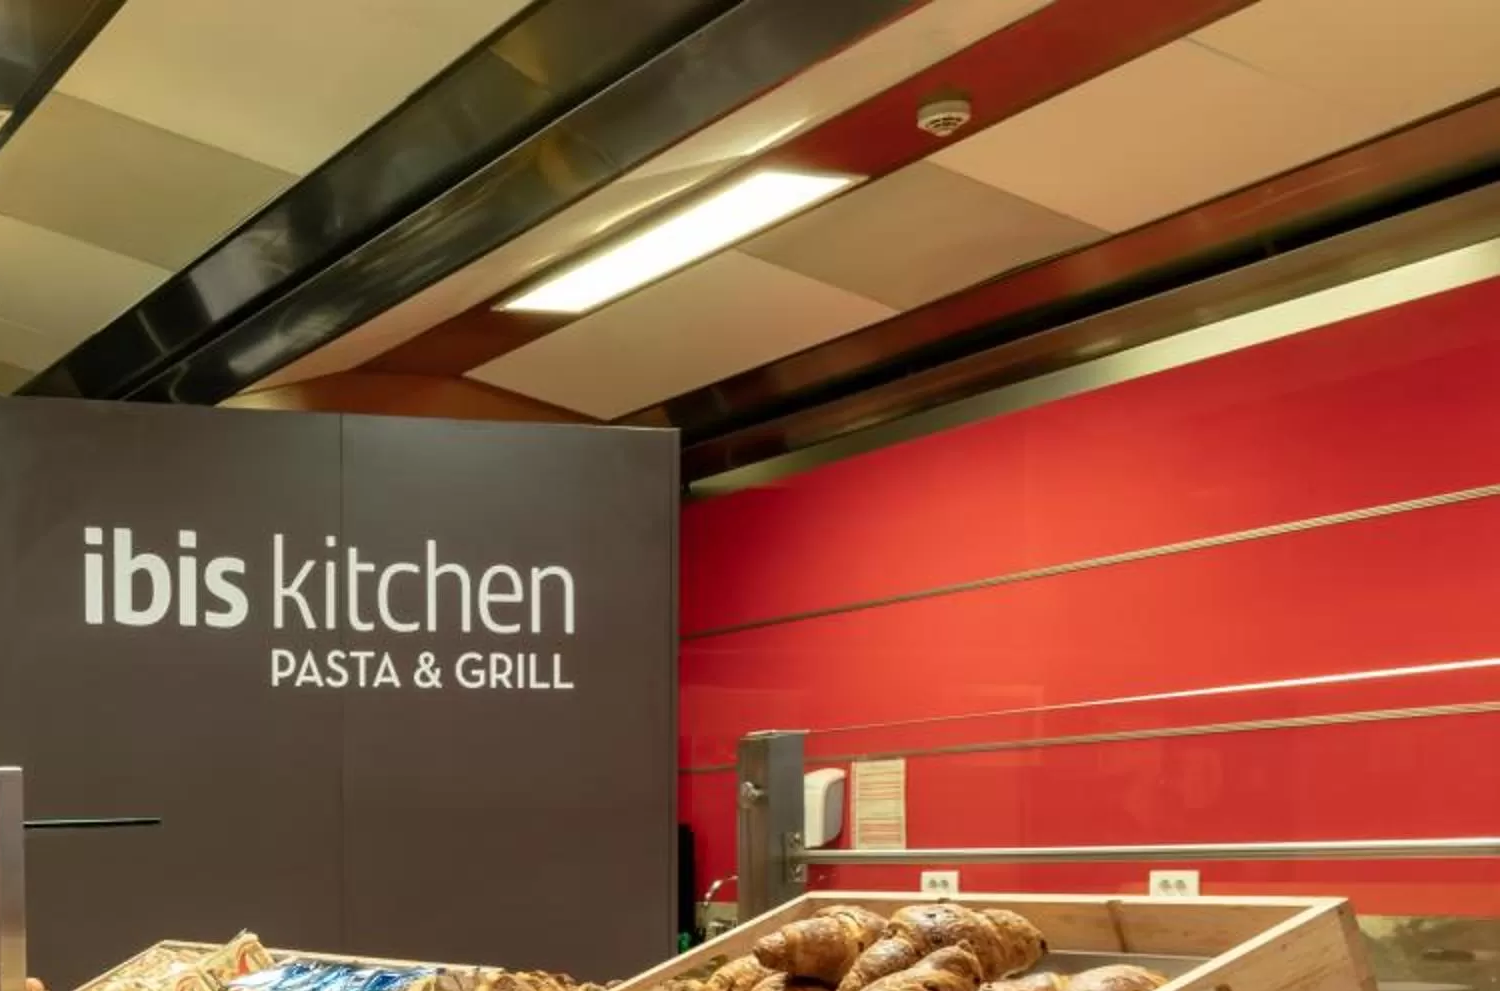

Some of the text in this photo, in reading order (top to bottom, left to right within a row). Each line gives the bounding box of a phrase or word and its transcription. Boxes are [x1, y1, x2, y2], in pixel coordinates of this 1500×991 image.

[85, 526, 575, 634] ibis kitchen
[271, 649, 575, 689] PASTA & GRILL
